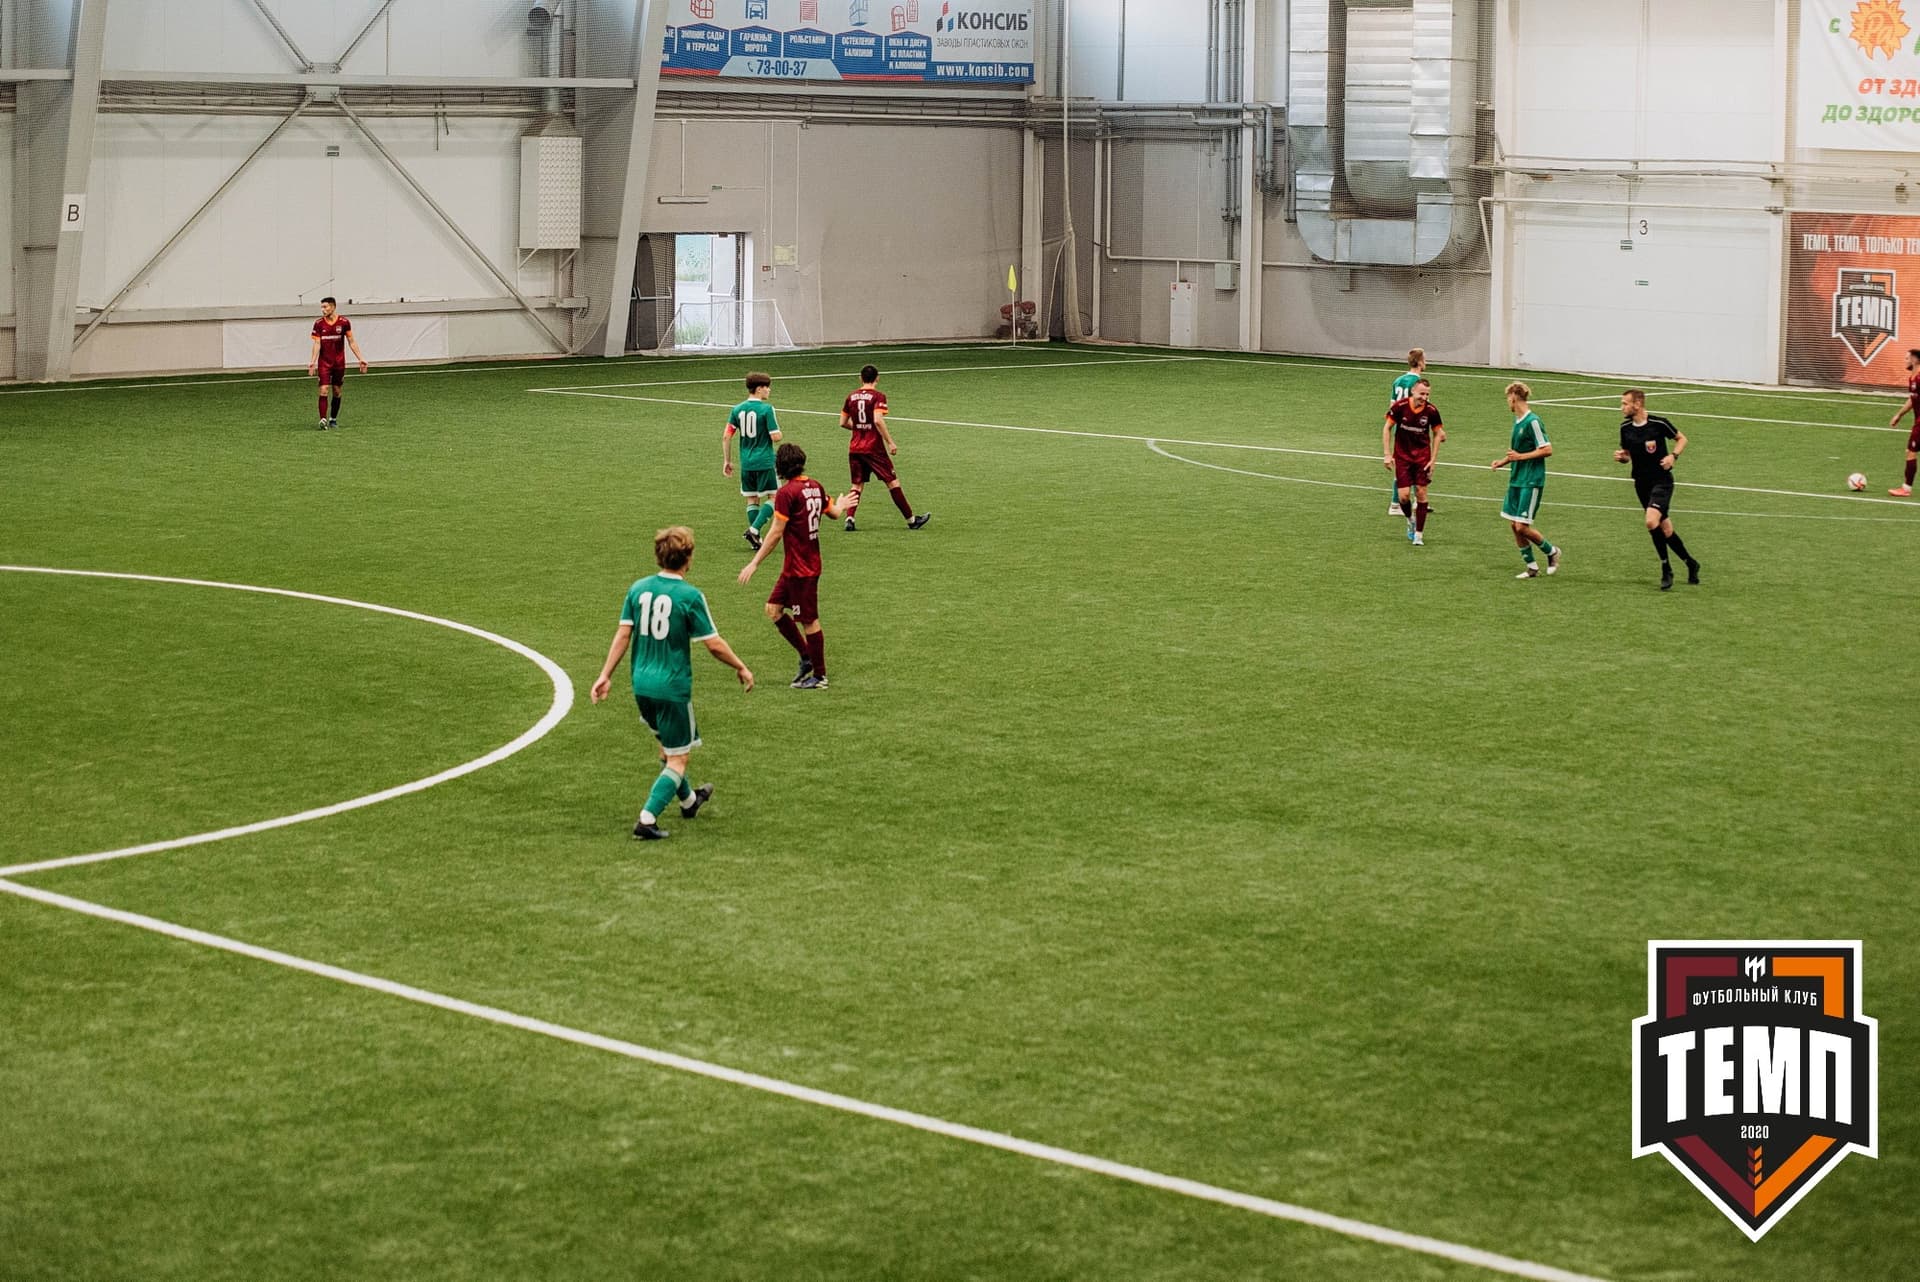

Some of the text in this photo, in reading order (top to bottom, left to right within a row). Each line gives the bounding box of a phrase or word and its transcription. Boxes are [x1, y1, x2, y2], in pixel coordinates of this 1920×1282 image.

[958, 12, 1028, 31] КОНСИБ
[937, 38, 962, 48] ЗАВОДЫ
[757, 60, 807, 75] 73-00-37
[937, 64, 1029, 77] www.konsib.com
[1858, 79, 1920, 98] ОТ ЗД
[1821, 105, 1852, 123] ДО
[1639, 219, 1649, 236] 3
[1803, 234, 1831, 252] ТЕМП,
[1834, 235, 1862, 253] ТЕМП,
[1865, 236, 1903, 254] ТОЛЬКО
[1840, 296, 1893, 330] ТЕМП
[857, 400, 867, 424] 8
[738, 410, 757, 438] 10
[638, 591, 672, 640] 18
